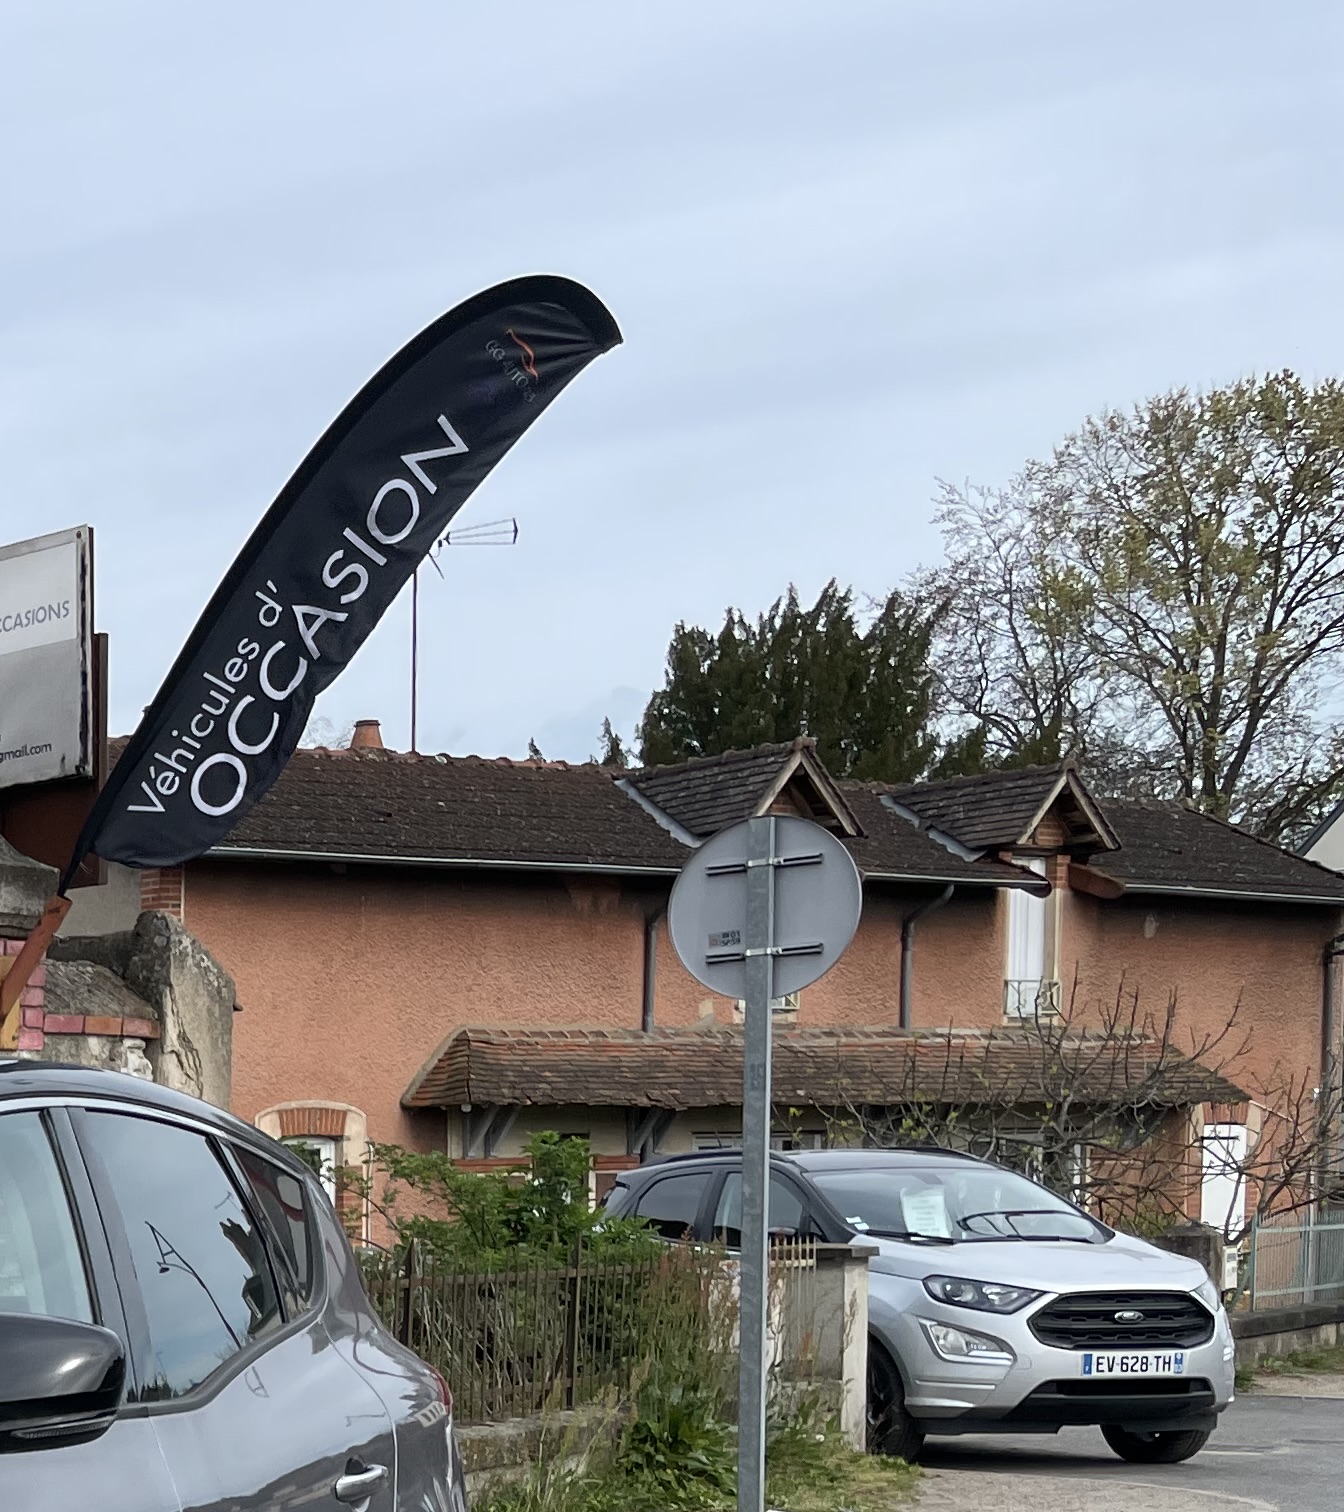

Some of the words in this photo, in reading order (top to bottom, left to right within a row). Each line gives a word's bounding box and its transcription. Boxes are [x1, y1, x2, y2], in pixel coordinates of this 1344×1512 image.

[127, 636, 261, 814] Véhicules
[255, 580, 284, 629] d'
[190, 414, 469, 816] OCCASION
[1096, 1356, 1172, 1373] EV-628-TH
